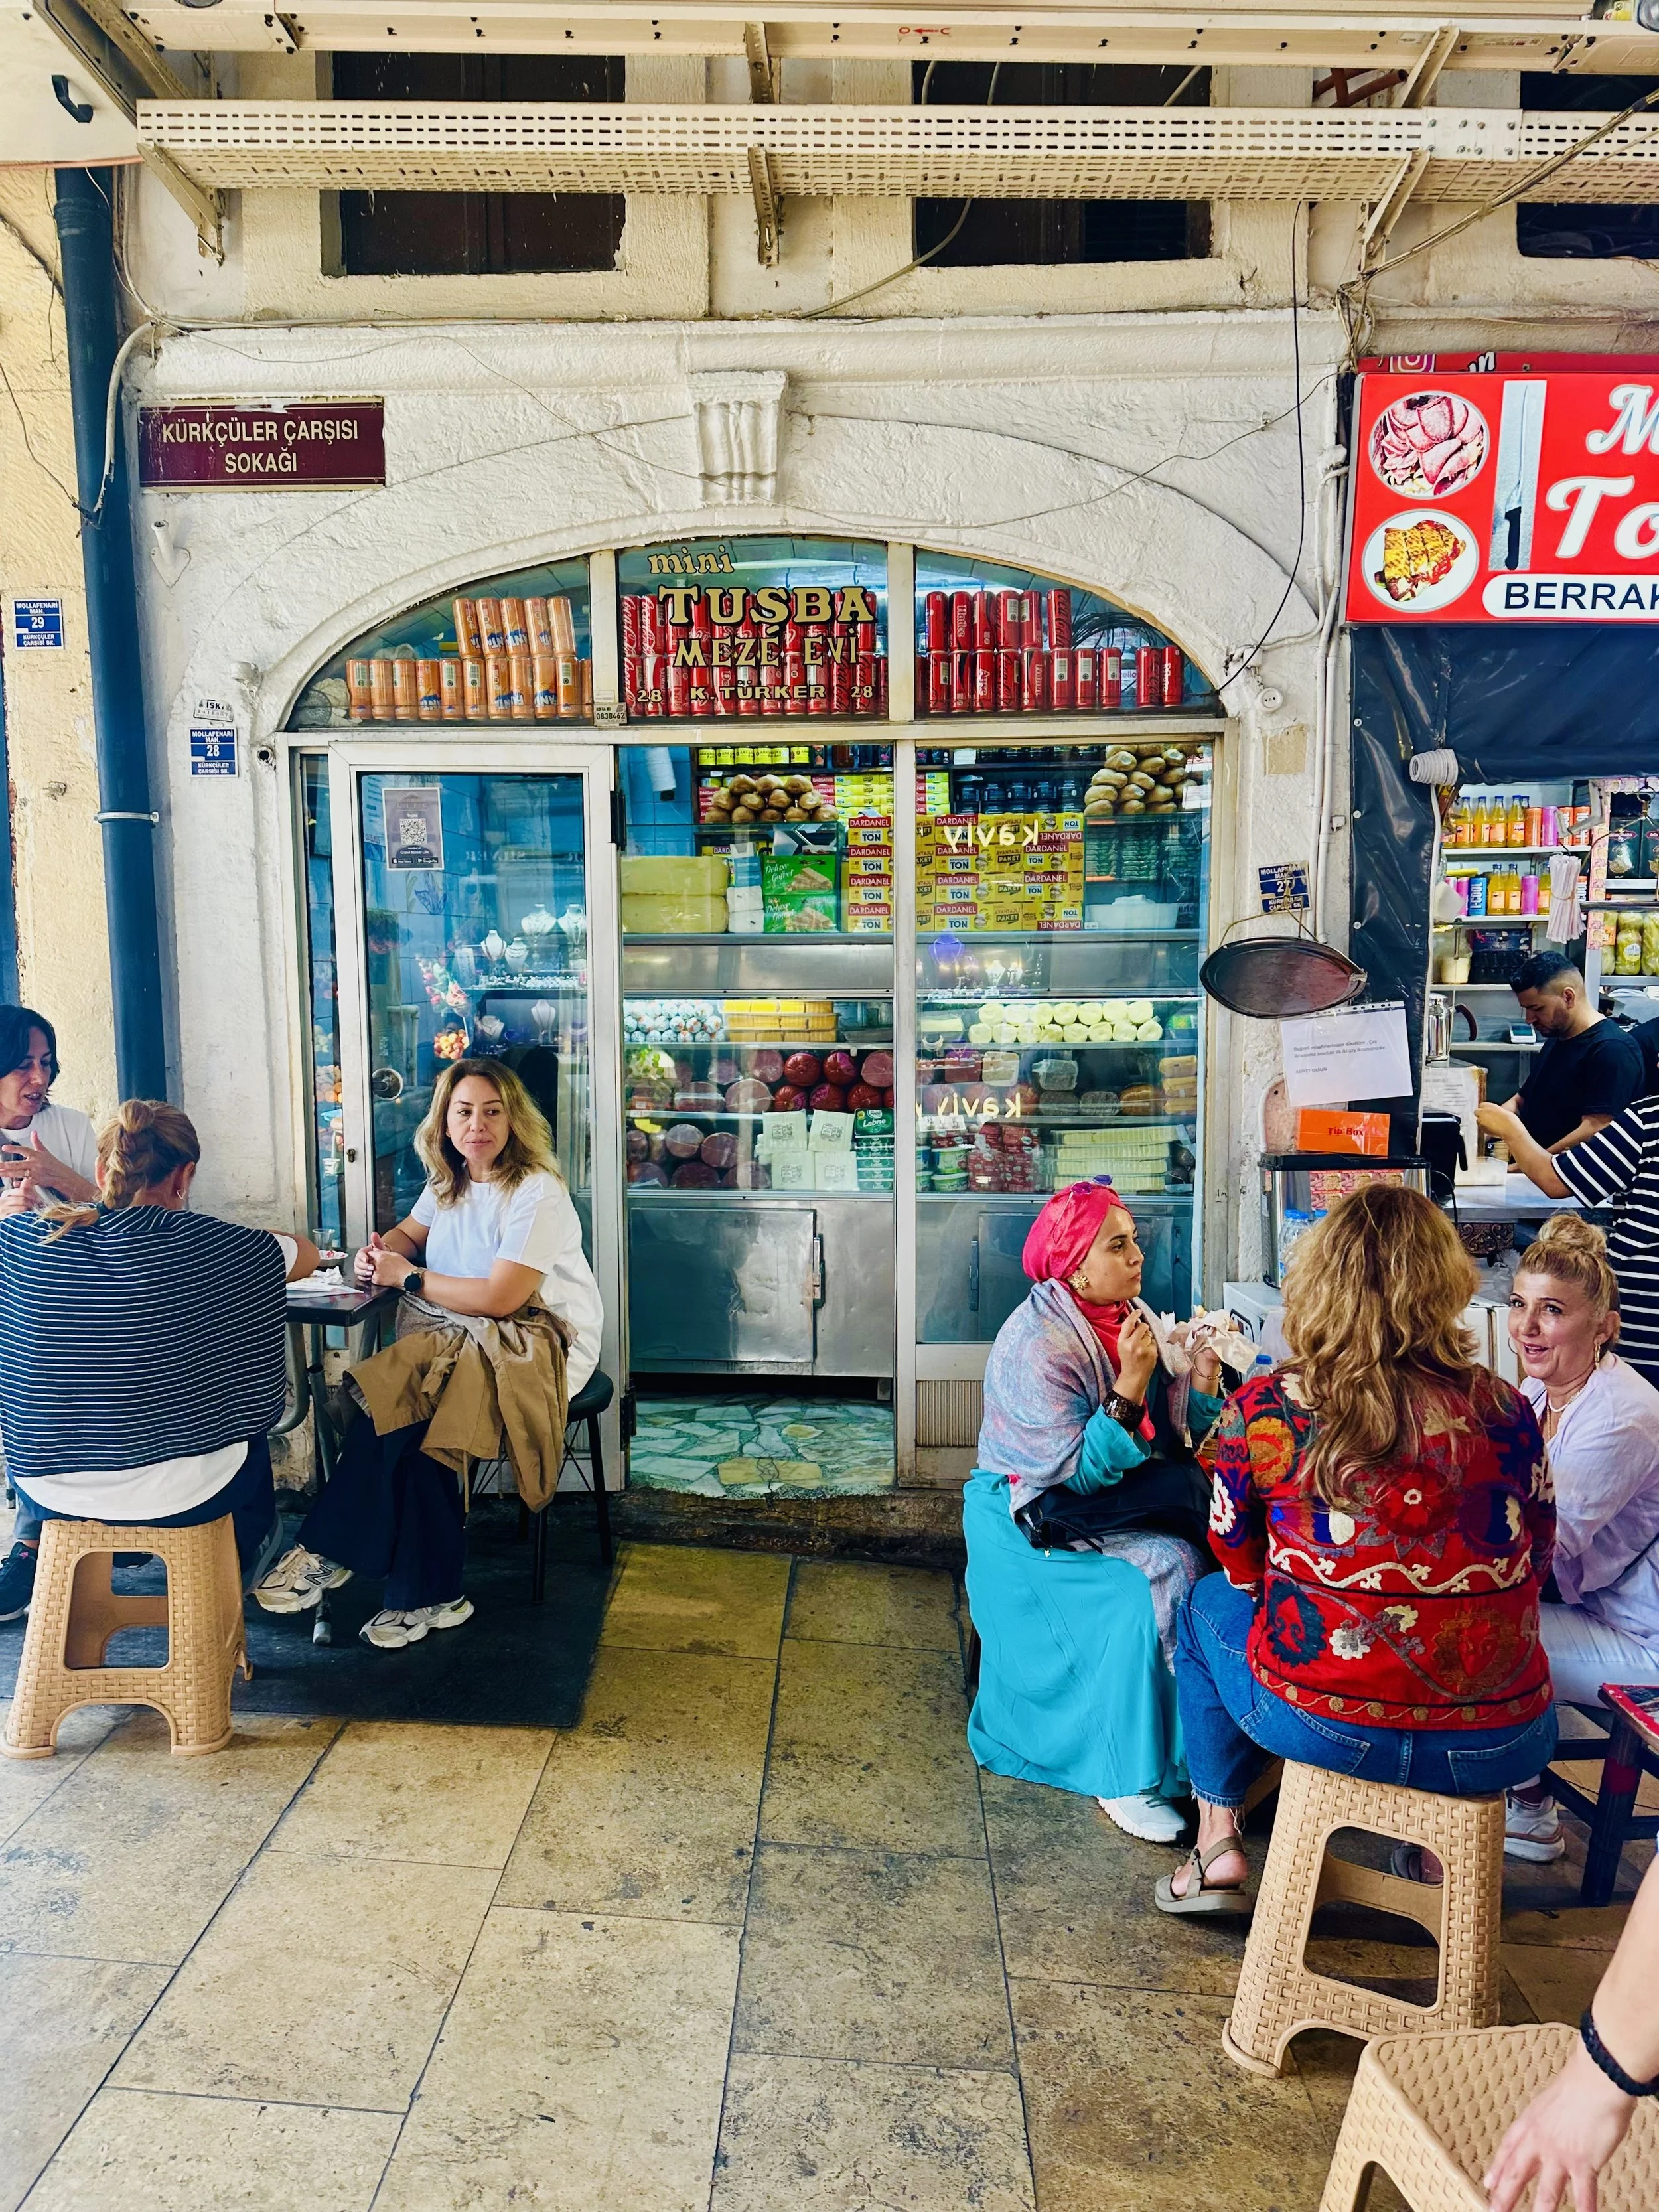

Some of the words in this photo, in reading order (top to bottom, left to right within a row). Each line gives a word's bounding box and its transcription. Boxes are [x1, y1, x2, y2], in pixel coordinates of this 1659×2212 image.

[162, 417, 278, 447] KÜRKÇÜLER
[283, 419, 358, 446] ÇARŞISI
[224, 447, 297, 473] SOKAĞI
[648, 544, 735, 575] mini
[31, 617, 45, 628] 29
[957, 605, 968, 637] Hatice
[804, 628, 857, 666] EVİ
[637, 690, 662, 702] 28
[690, 686, 715, 700] K.
[719, 680, 826, 700] TÜRKER
[851, 686, 873, 698] 28
[206, 745, 220, 757] 28
[1025, 844, 1068, 853] DARDANEL
[1469, 882, 1482, 909] I-COOL
[948, 920, 968, 928] TON
